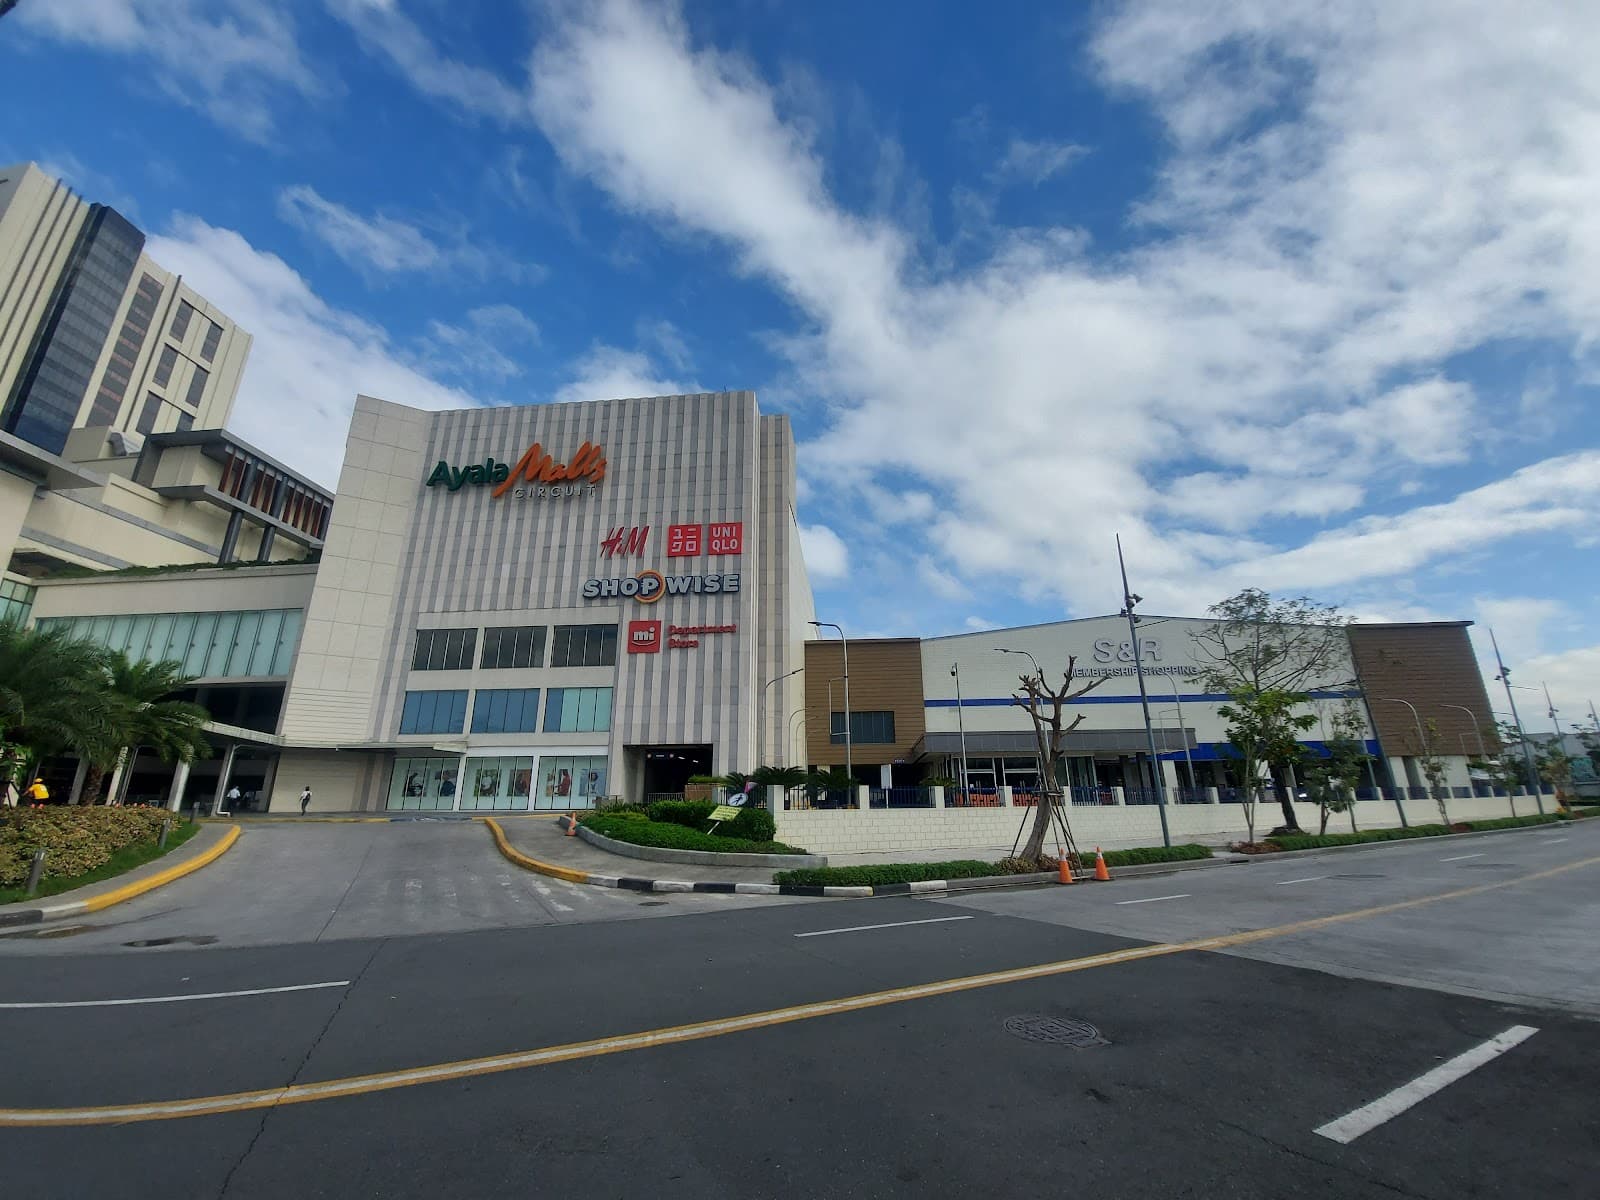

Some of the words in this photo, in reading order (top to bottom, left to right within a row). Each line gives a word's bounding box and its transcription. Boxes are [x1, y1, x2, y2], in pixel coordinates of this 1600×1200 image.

[426, 457, 510, 491] Ayala
[492, 441, 607, 498] Malls
[514, 485, 597, 499] CIRCUIT
[712, 526, 736, 538] UNI
[600, 526, 651, 558] H&M
[712, 538, 738, 553] QLO
[633, 626, 656, 641] mi
[1092, 638, 1163, 663] S&R
[1141, 664, 1199, 677] SHOPPING
